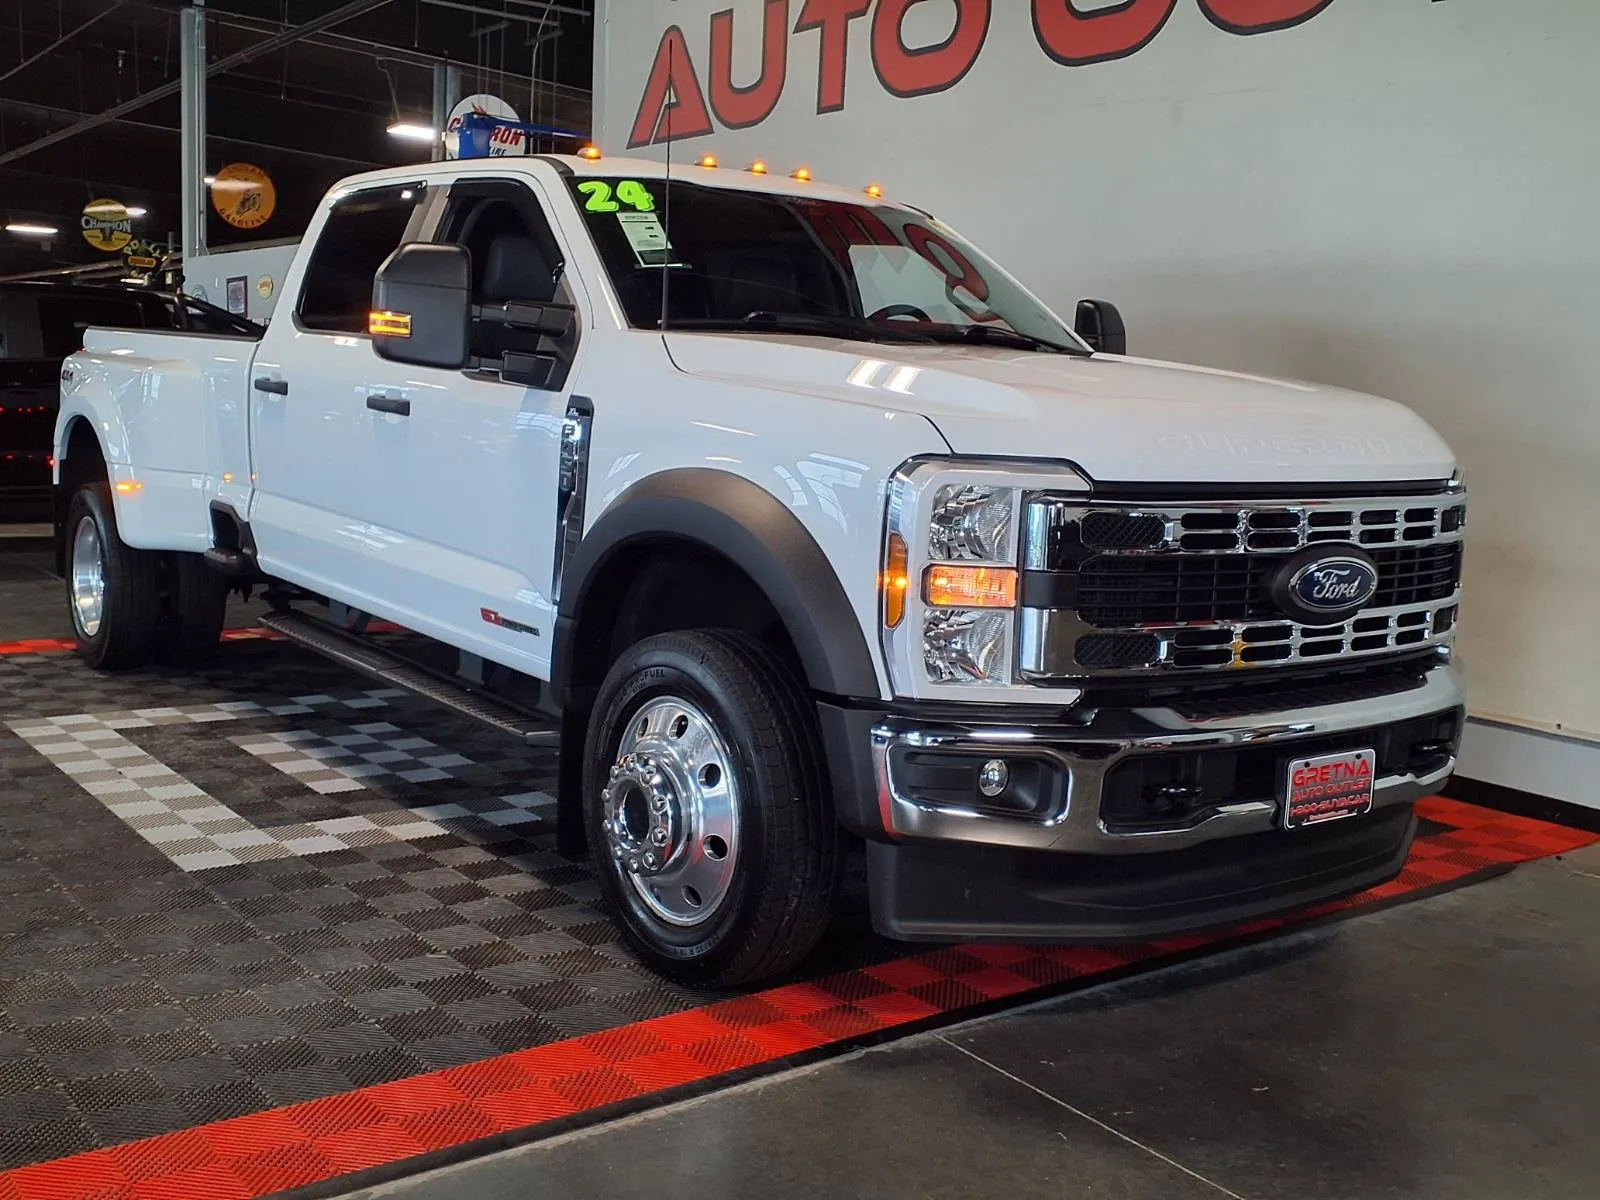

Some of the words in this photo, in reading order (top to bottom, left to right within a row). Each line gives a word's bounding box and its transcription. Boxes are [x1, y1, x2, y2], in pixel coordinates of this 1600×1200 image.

[626, 0, 992, 150] AUTO
[448, 116, 525, 147] CRON
[577, 180, 655, 212] 24
[1312, 568, 1362, 599] Ford
[1293, 759, 1371, 788] GRETNA
[1292, 785, 1324, 802] AUTO
[1326, 777, 1372, 796] OUTLET
